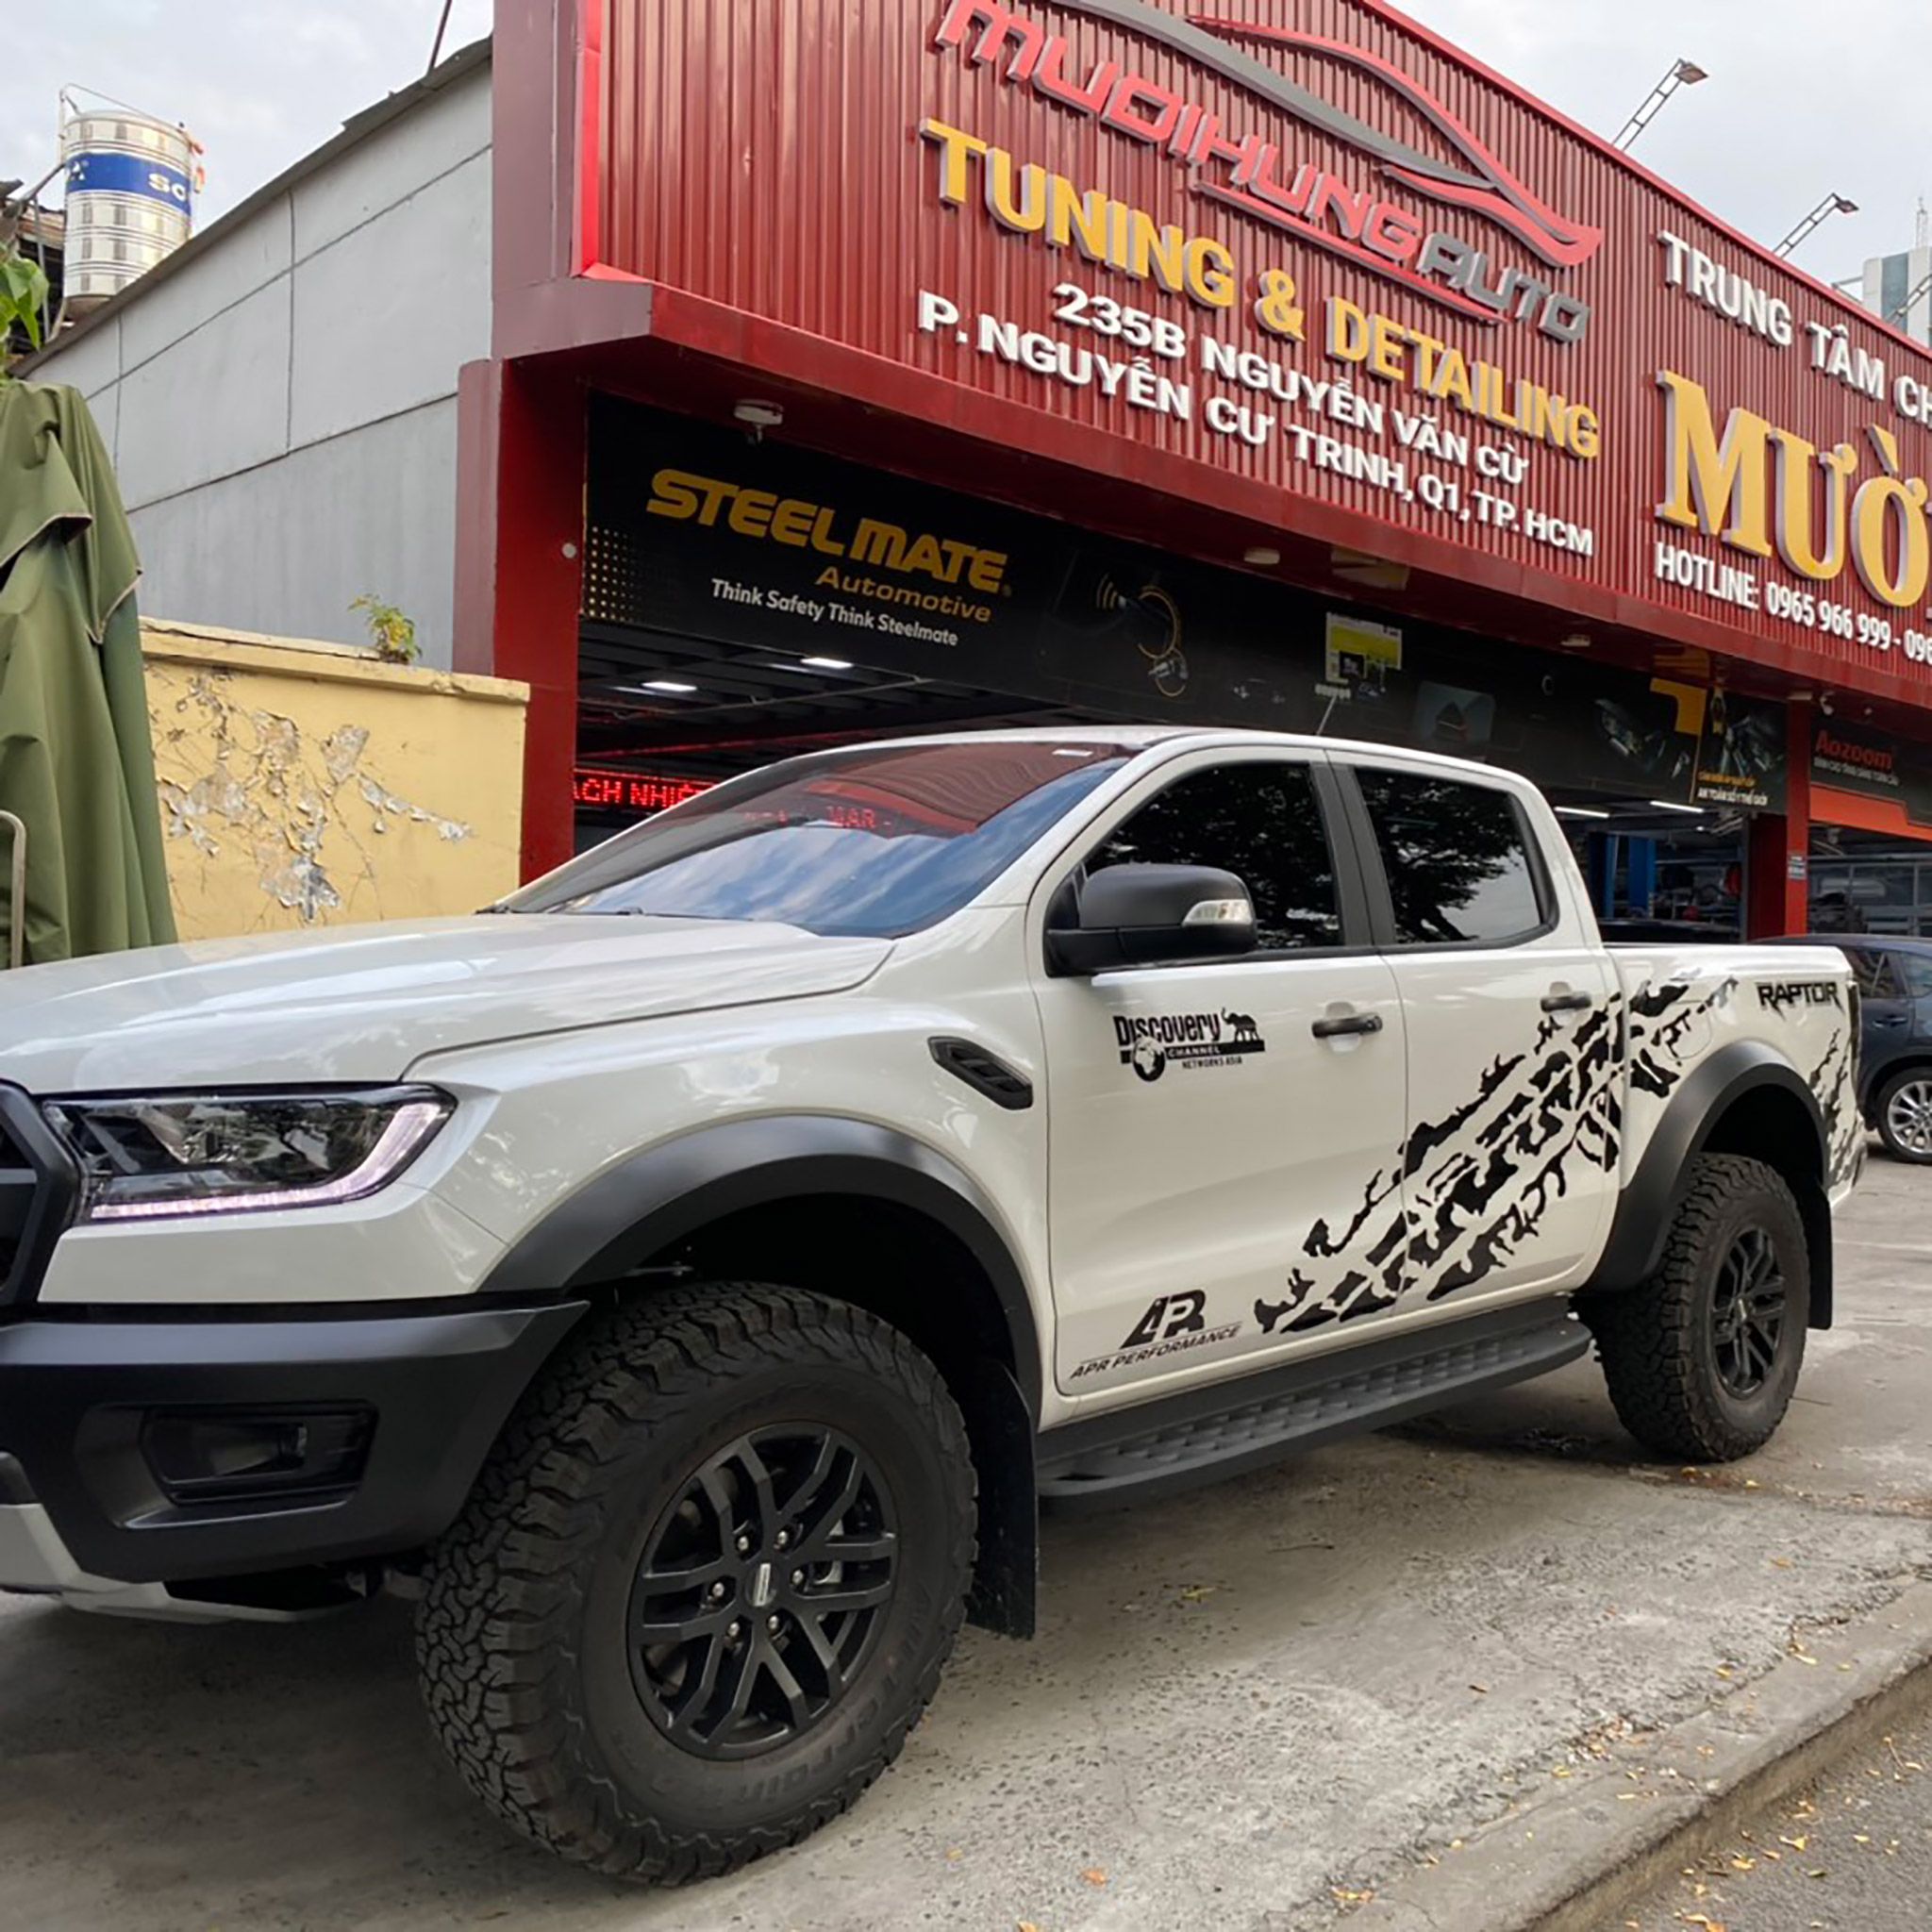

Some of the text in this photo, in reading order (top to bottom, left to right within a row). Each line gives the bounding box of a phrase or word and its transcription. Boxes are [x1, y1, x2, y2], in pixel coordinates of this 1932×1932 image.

[920, 118, 1599, 459] TUNING & DETAILING
[1657, 229, 1792, 347] TRUNG
[1806, 324, 1885, 400] TÂM
[1053, 283, 1529, 484] 235B NGUYỄN VĂN CỪ
[977, 313, 1190, 420] NGUYỄN
[1205, 396, 1274, 445] CƯ
[1525, 509, 1594, 558] HCM
[1656, 369, 1932, 608] MƯỜ
[711, 578, 958, 646] Think Safety Think Steelmate
[814, 566, 991, 623] Automotive
[1766, 581, 1815, 627] 0965
[1818, 600, 1853, 640] 966
[1815, 730, 1892, 772] Aozoom
[1757, 982, 1846, 1022] RAPTOR
[1168, 1045, 1222, 1058] CHANNEL
[1070, 1324, 1241, 1380] APR PERFORMANCE
